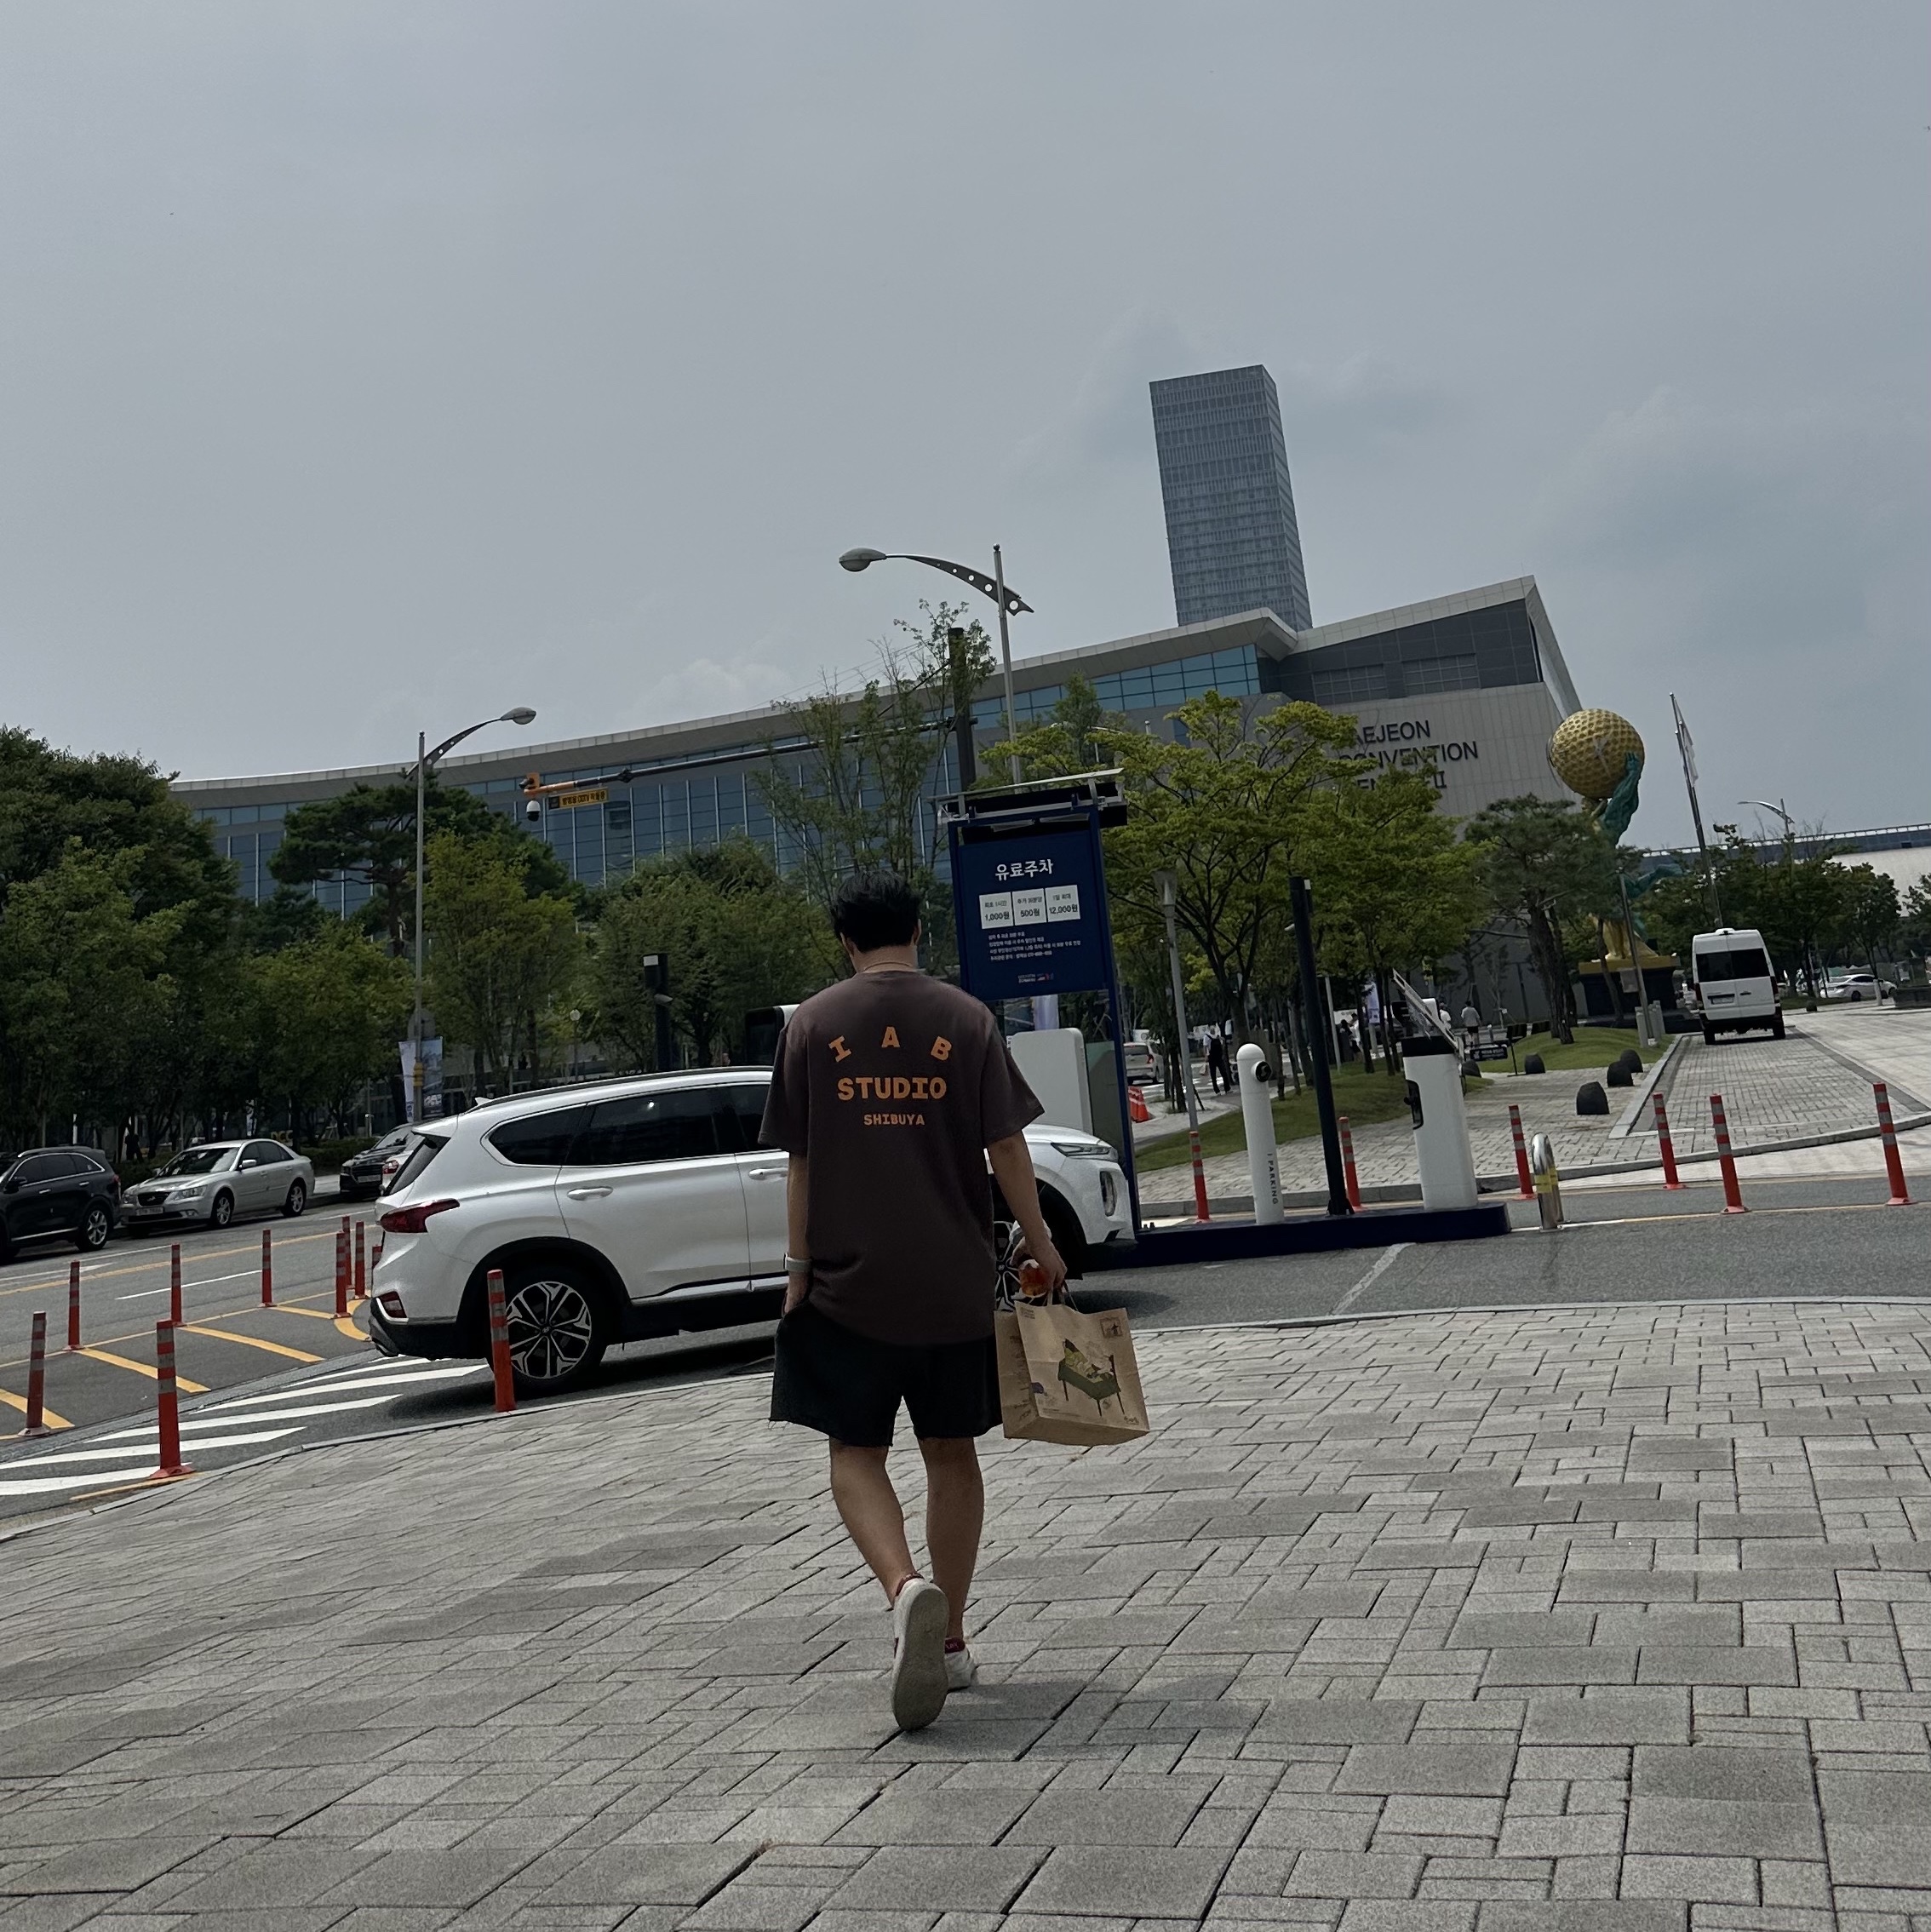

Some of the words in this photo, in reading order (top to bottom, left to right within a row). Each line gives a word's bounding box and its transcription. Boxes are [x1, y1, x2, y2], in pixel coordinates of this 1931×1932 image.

[1356, 720, 1430, 744] EJEON
[995, 858, 1053, 880] 유료주차
[837, 1076, 947, 1101] STUDIO
[863, 1114, 925, 1126] SHIBUYA
